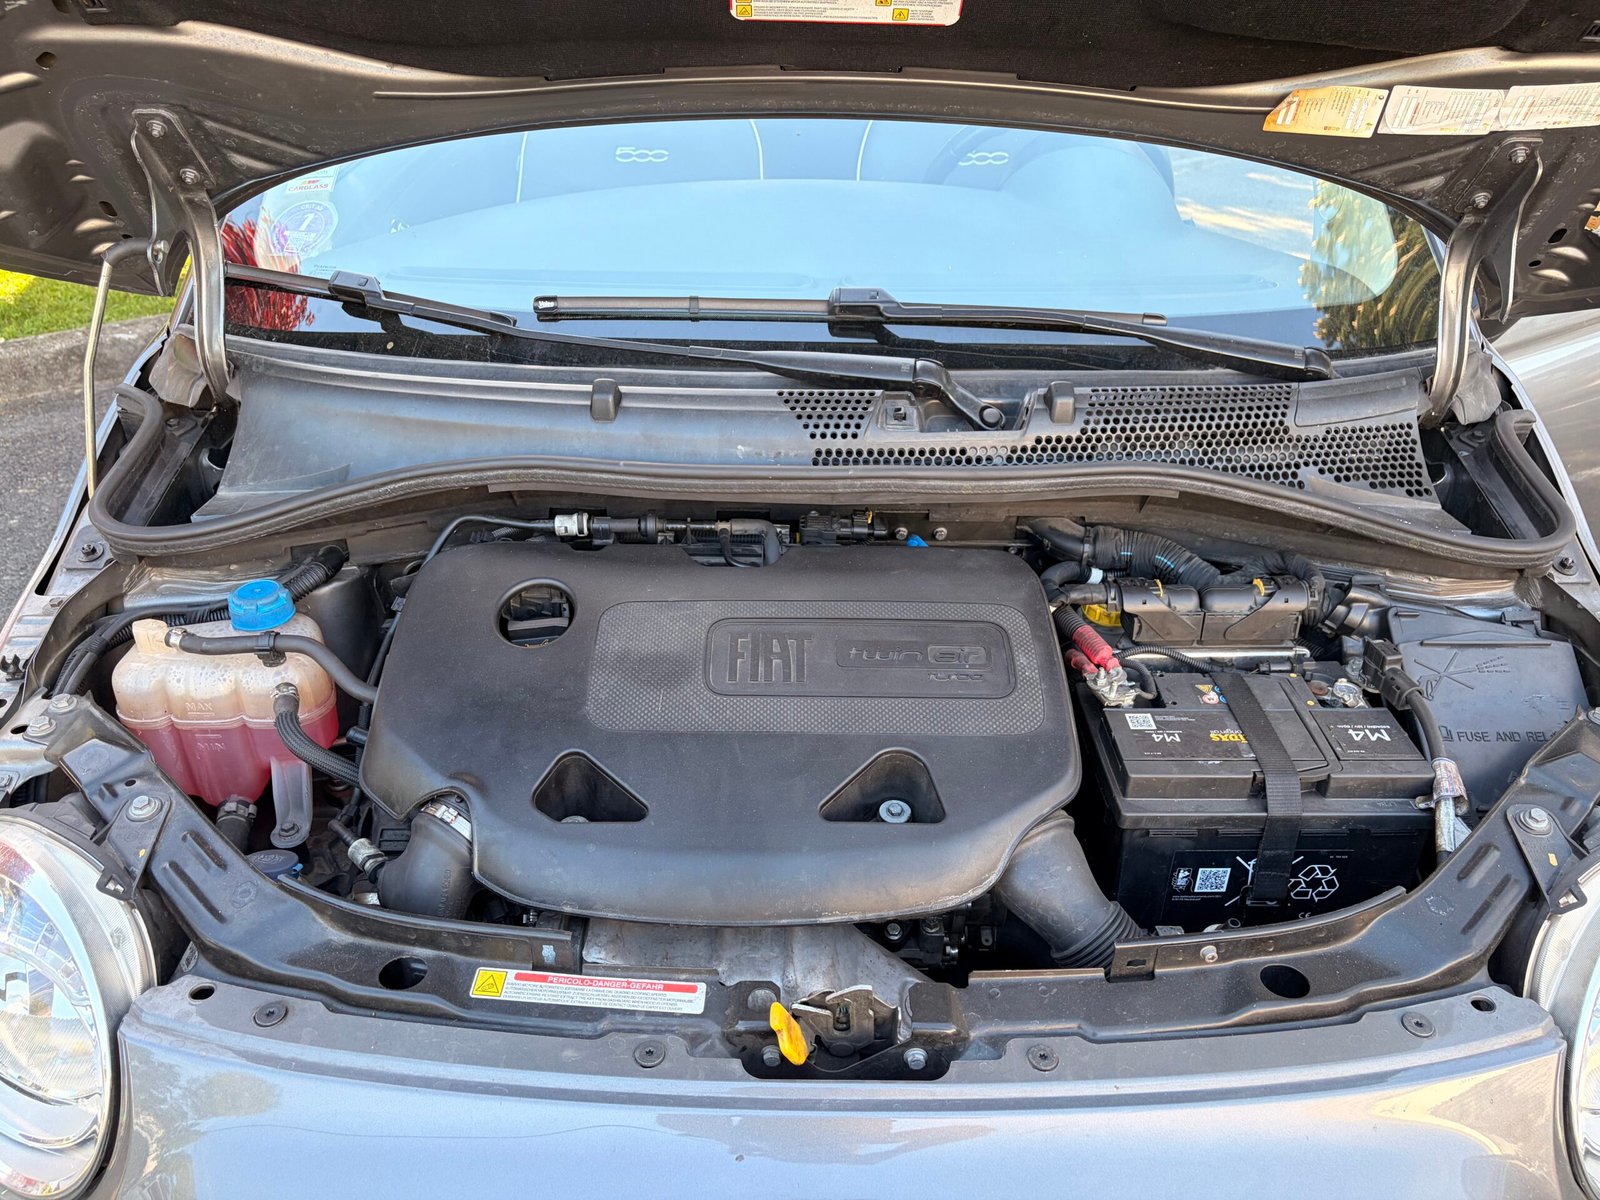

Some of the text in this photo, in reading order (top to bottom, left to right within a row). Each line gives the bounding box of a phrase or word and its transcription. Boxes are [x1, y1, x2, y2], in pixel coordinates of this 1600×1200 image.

[615, 146, 670, 163] 500
[300, 212, 316, 231] 1
[727, 631, 813, 684] FIAT
[185, 702, 213, 711] MAX
[1152, 733, 1181, 743] M4
[1348, 729, 1391, 741] M4
[1457, 730, 1557, 742] FUSE AND REL
[197, 742, 225, 751] MIN
[547, 976, 664, 990] PERICOLO-DANGER-GEFAHR
